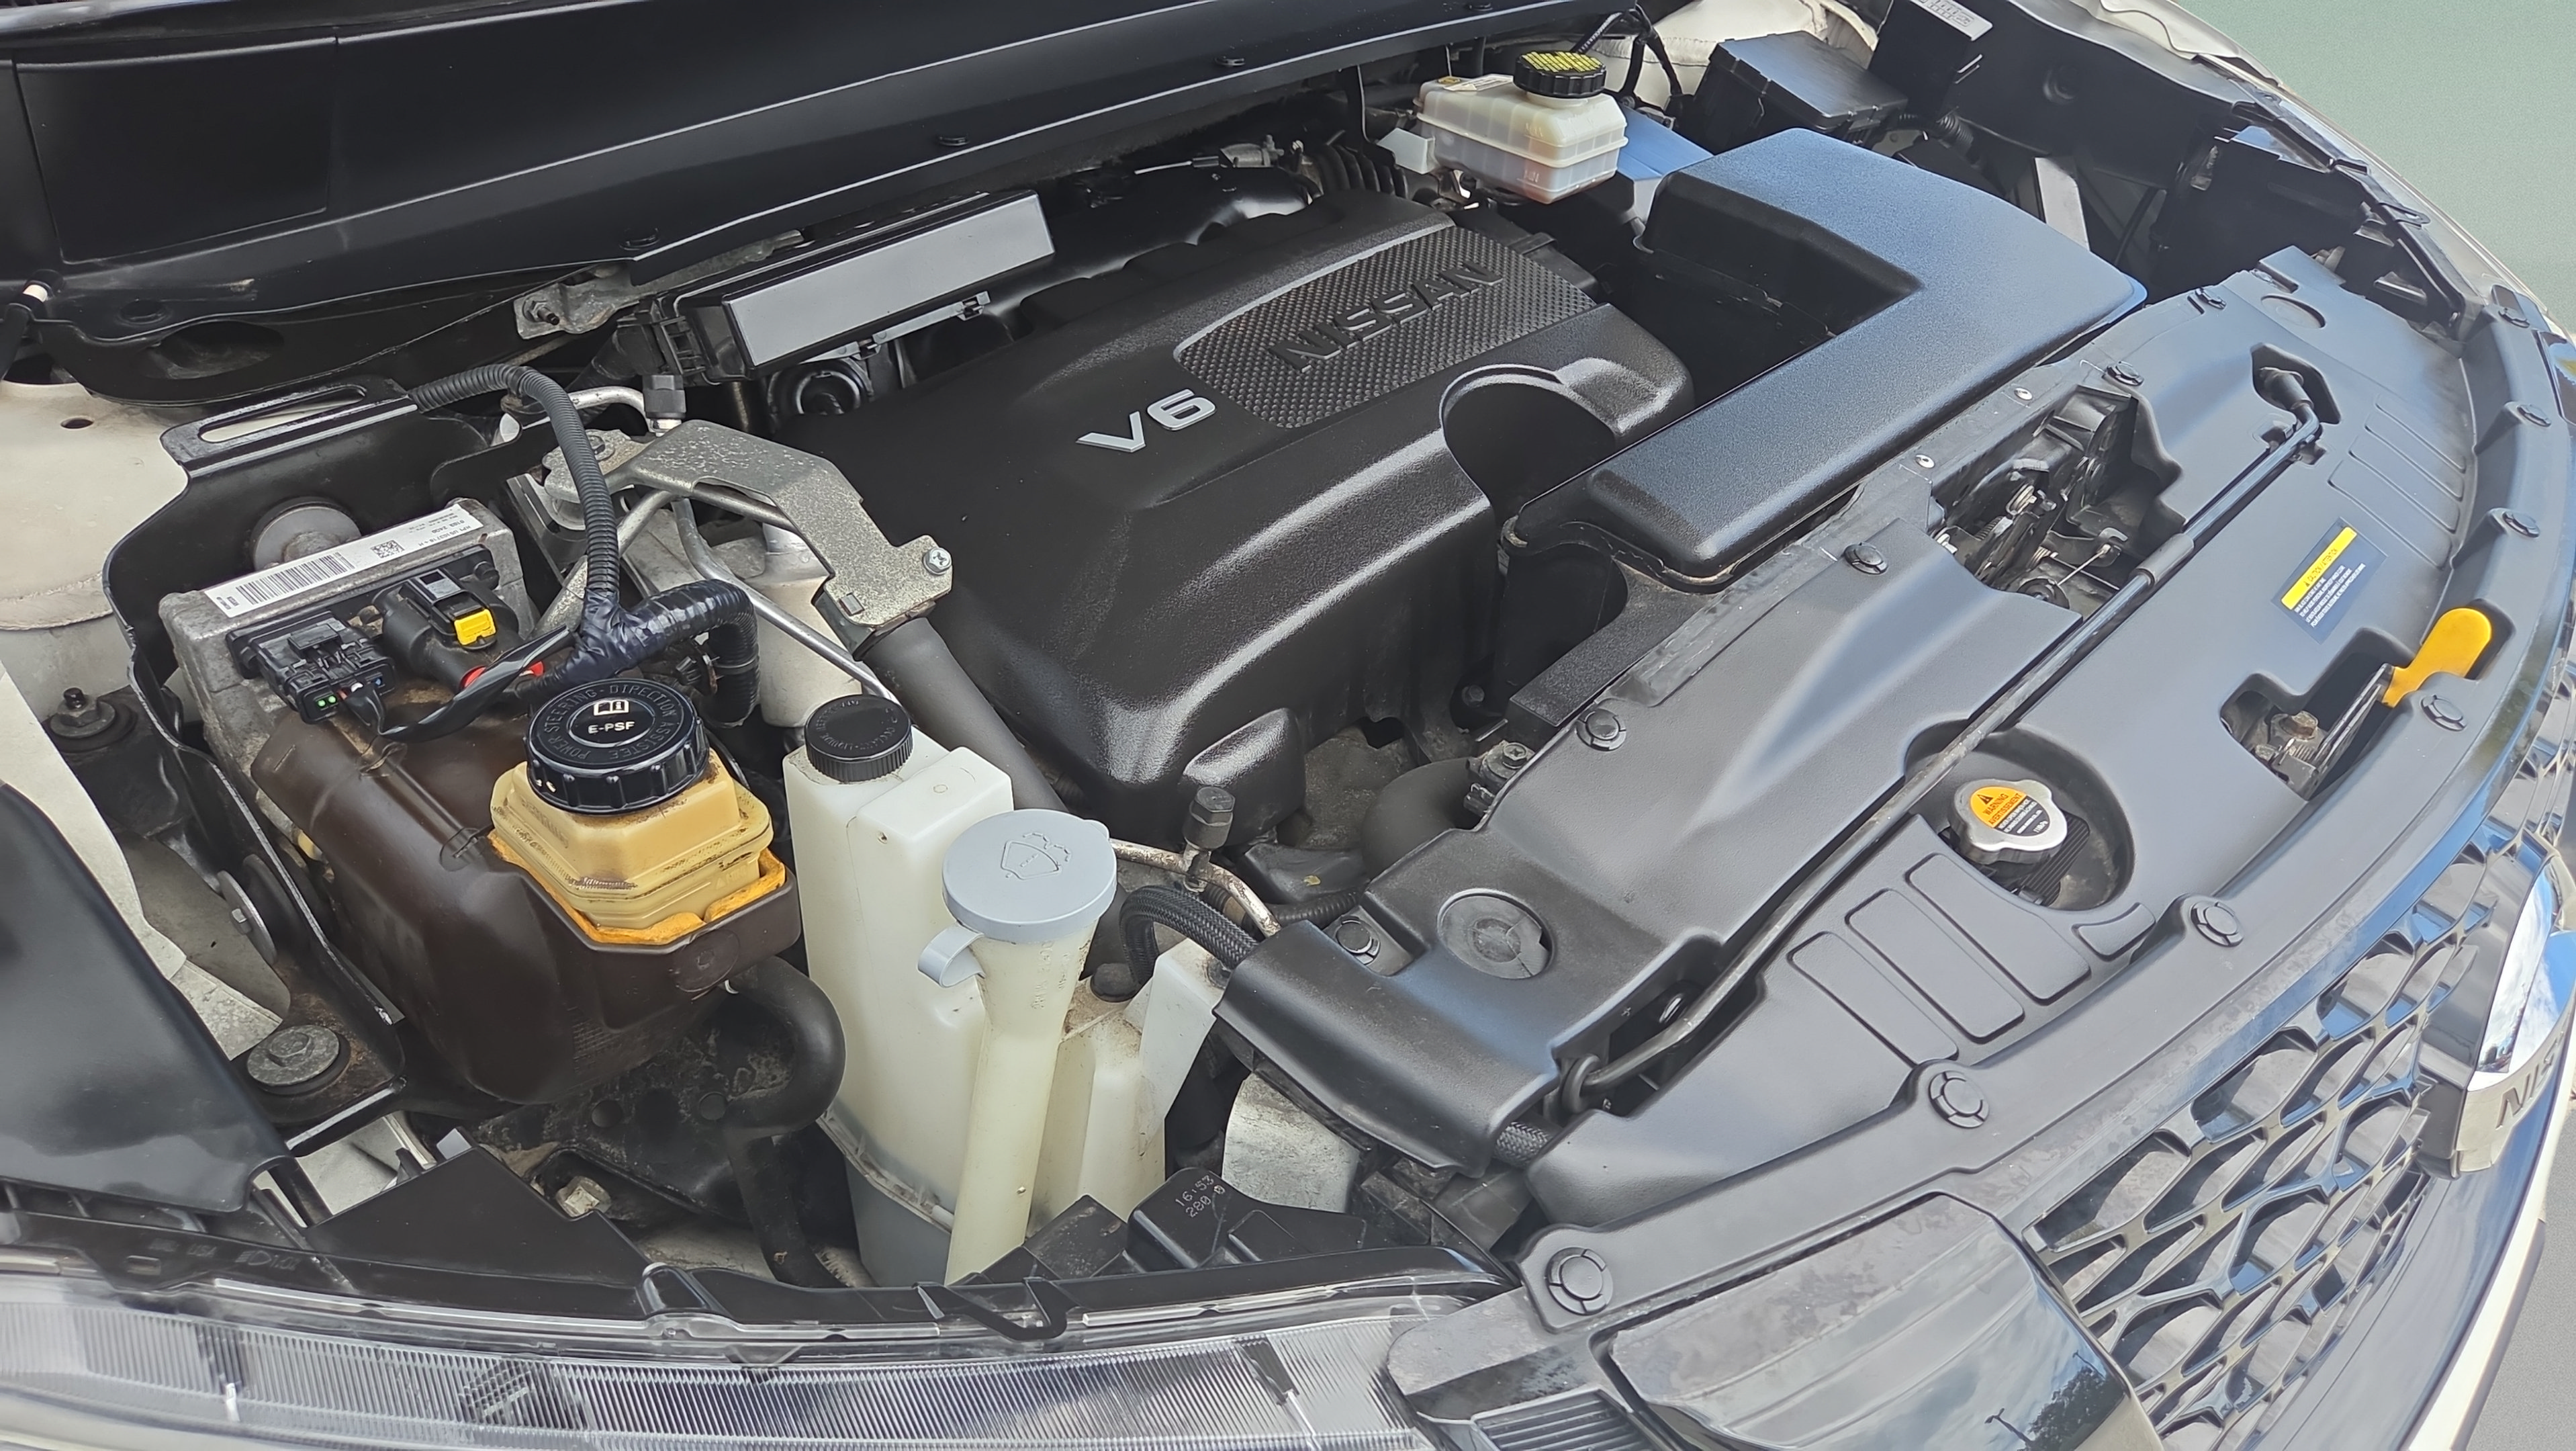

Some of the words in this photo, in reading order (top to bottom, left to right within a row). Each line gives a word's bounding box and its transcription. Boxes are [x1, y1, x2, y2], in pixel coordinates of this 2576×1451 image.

[1268, 260, 1503, 373] NISSAN
[1076, 388, 1217, 453] V6
[544, 689, 598, 734] STEERING
[610, 684, 677, 719] DIRECTION
[588, 721, 635, 734] E-PSF
[1982, 793, 2009, 816] WARNING
[1988, 793, 2022, 825] AVERTISSEMENT
